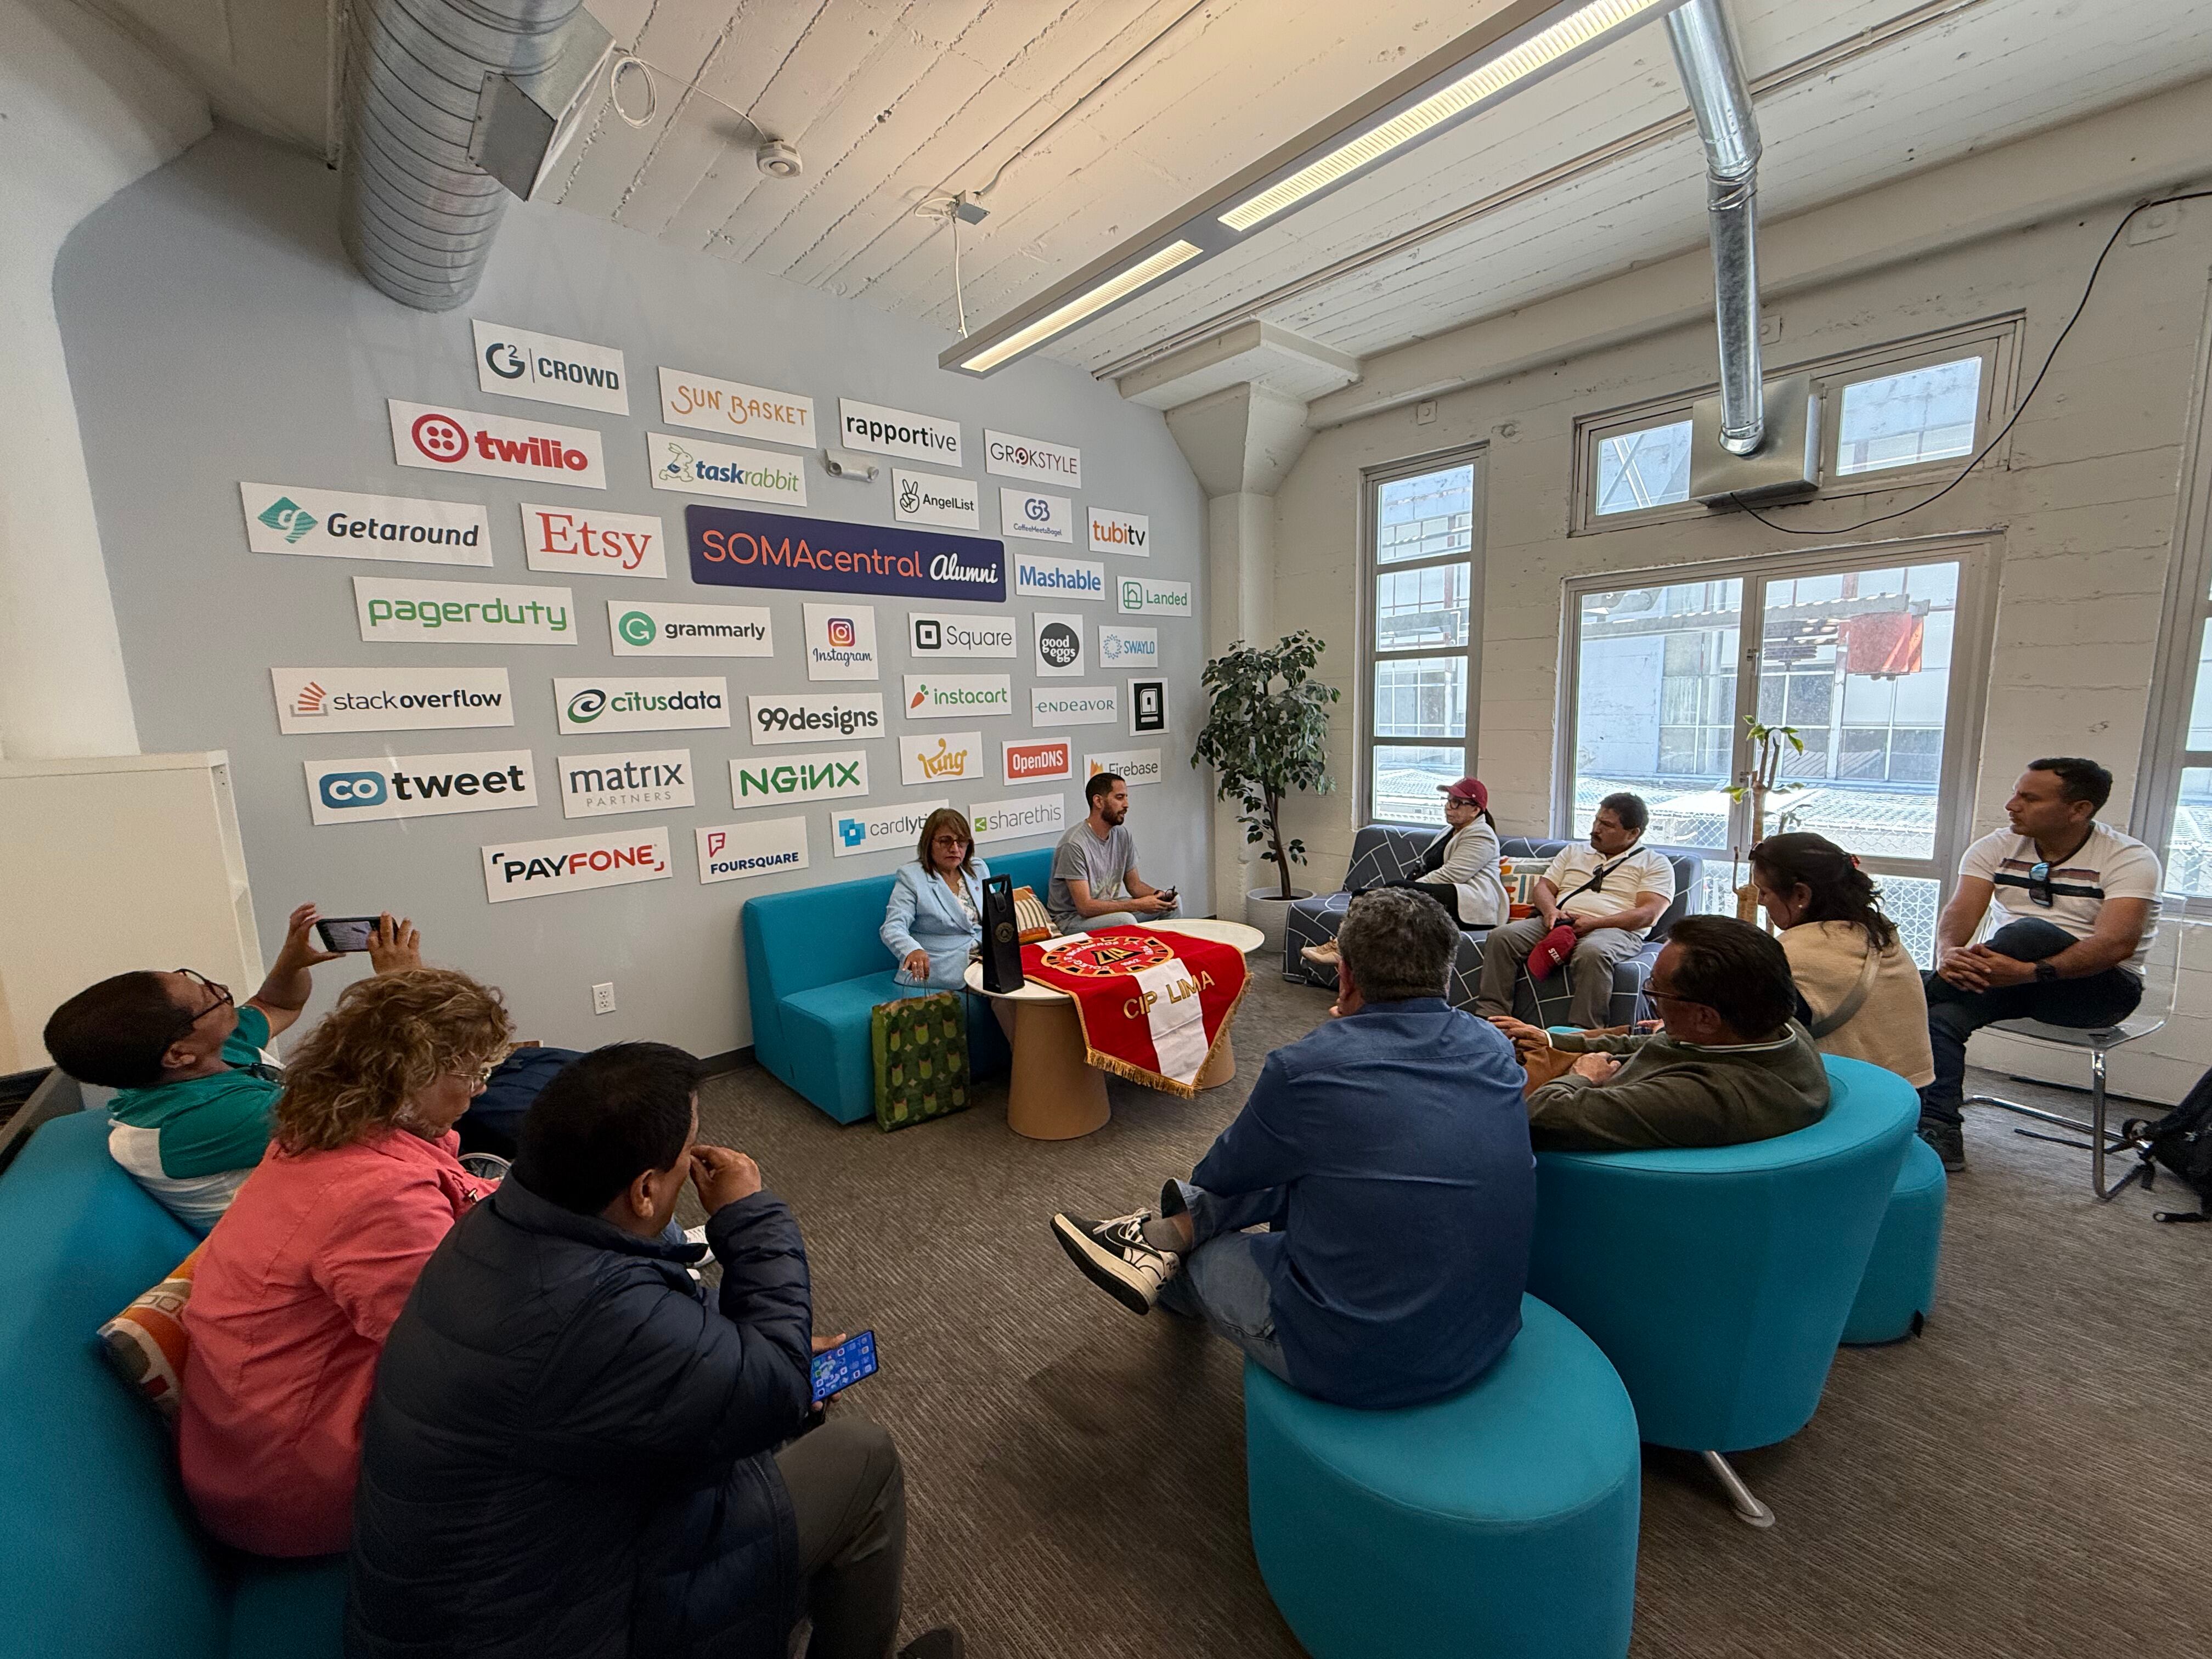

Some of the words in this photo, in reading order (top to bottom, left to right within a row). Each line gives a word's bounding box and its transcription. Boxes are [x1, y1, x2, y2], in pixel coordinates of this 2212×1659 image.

[538, 357, 619, 390] CROWD
[670, 385, 722, 415] SUN
[727, 396, 807, 426] BASKET
[847, 415, 957, 452] rapportive
[474, 430, 589, 471] twilio
[990, 442, 1077, 475] GROKSTYLE
[696, 460, 799, 492] taskrabbit
[922, 493, 974, 511] AngelList
[327, 512, 479, 547] Getaround
[535, 512, 652, 569] Etsy
[1093, 520, 1146, 546] tubitv
[703, 529, 923, 578] SOMAcentral
[930, 553, 998, 584] Alumni
[1020, 565, 1101, 591] Mashable
[1146, 589, 1187, 606] Landed
[368, 597, 567, 631] pagerduty
[665, 622, 765, 641] grammarly
[946, 625, 1012, 650] Square
[1041, 634, 1070, 653] good
[812, 647, 873, 667] Instagram
[1049, 648, 1076, 663] eggs
[1124, 640, 1155, 654] SWAYLO
[934, 687, 1007, 705] instacart
[757, 706, 878, 735] 99designs
[917, 738, 968, 778] King
[1012, 750, 1063, 773] OpenDNS
[1109, 761, 1158, 776] Firebase
[391, 765, 526, 800] tweet
[569, 761, 685, 793] matrix
[586, 791, 672, 808] PARTNERS
[870, 814, 927, 837] cardlyt
[989, 804, 1062, 830] sharethis
[504, 845, 654, 883] PAYFONE
[710, 852, 799, 874] FOURSQUARE
[1123, 991, 1158, 1019] CIP
[1165, 970, 1216, 1005] LIMA
